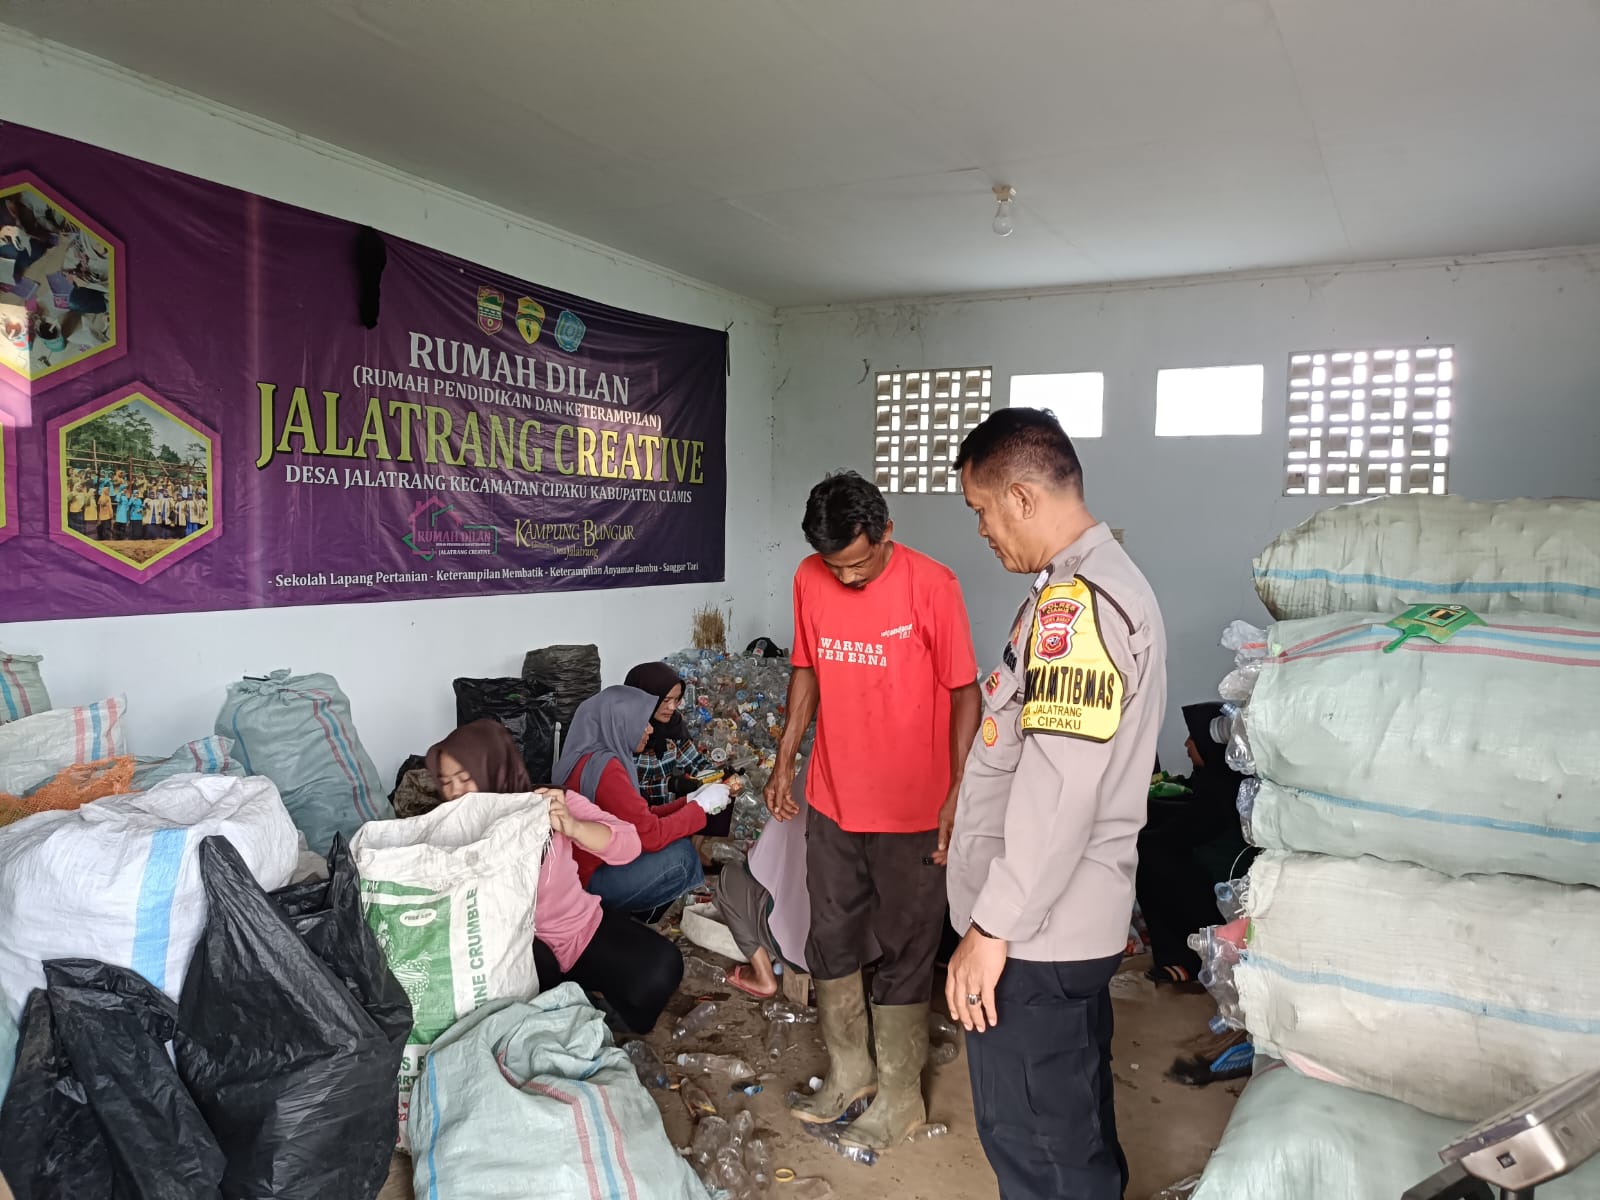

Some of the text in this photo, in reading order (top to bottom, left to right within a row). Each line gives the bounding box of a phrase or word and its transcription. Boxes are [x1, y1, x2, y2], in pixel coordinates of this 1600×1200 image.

[409, 331, 630, 406] RUMAH DILAN
[353, 365, 661, 432] (RUMAH PENDIDIKAN DAN KETERAMPILAN)
[256, 382, 705, 484] JALATRANG CREATIVE
[286, 465, 340, 485] DESA
[344, 469, 446, 490] JALATRANG
[450, 475, 539, 496] KECAMATAN
[542, 481, 587, 498] CIPAKU
[590, 484, 657, 502] KABUPATEN
[417, 530, 491, 543] RUMAH DILAN
[514, 518, 635, 548] KAMPUNG BUNGUR
[275, 573, 327, 587] Sekolah
[330, 572, 374, 588] Lapang
[375, 570, 428, 583] Pertanian
[436, 568, 501, 582] Keterampilan
[501, 567, 544, 579] Membatik
[550, 564, 602, 578] Keterampilan
[603, 564, 635, 576] Anyaman
[635, 563, 658, 573] Bambu
[820, 637, 883, 655] WARNAS
[1033, 704, 1082, 718] JALATRANG
[1037, 716, 1082, 730] CIPAKU
[466, 887, 488, 1009] INE CRUMBLE
